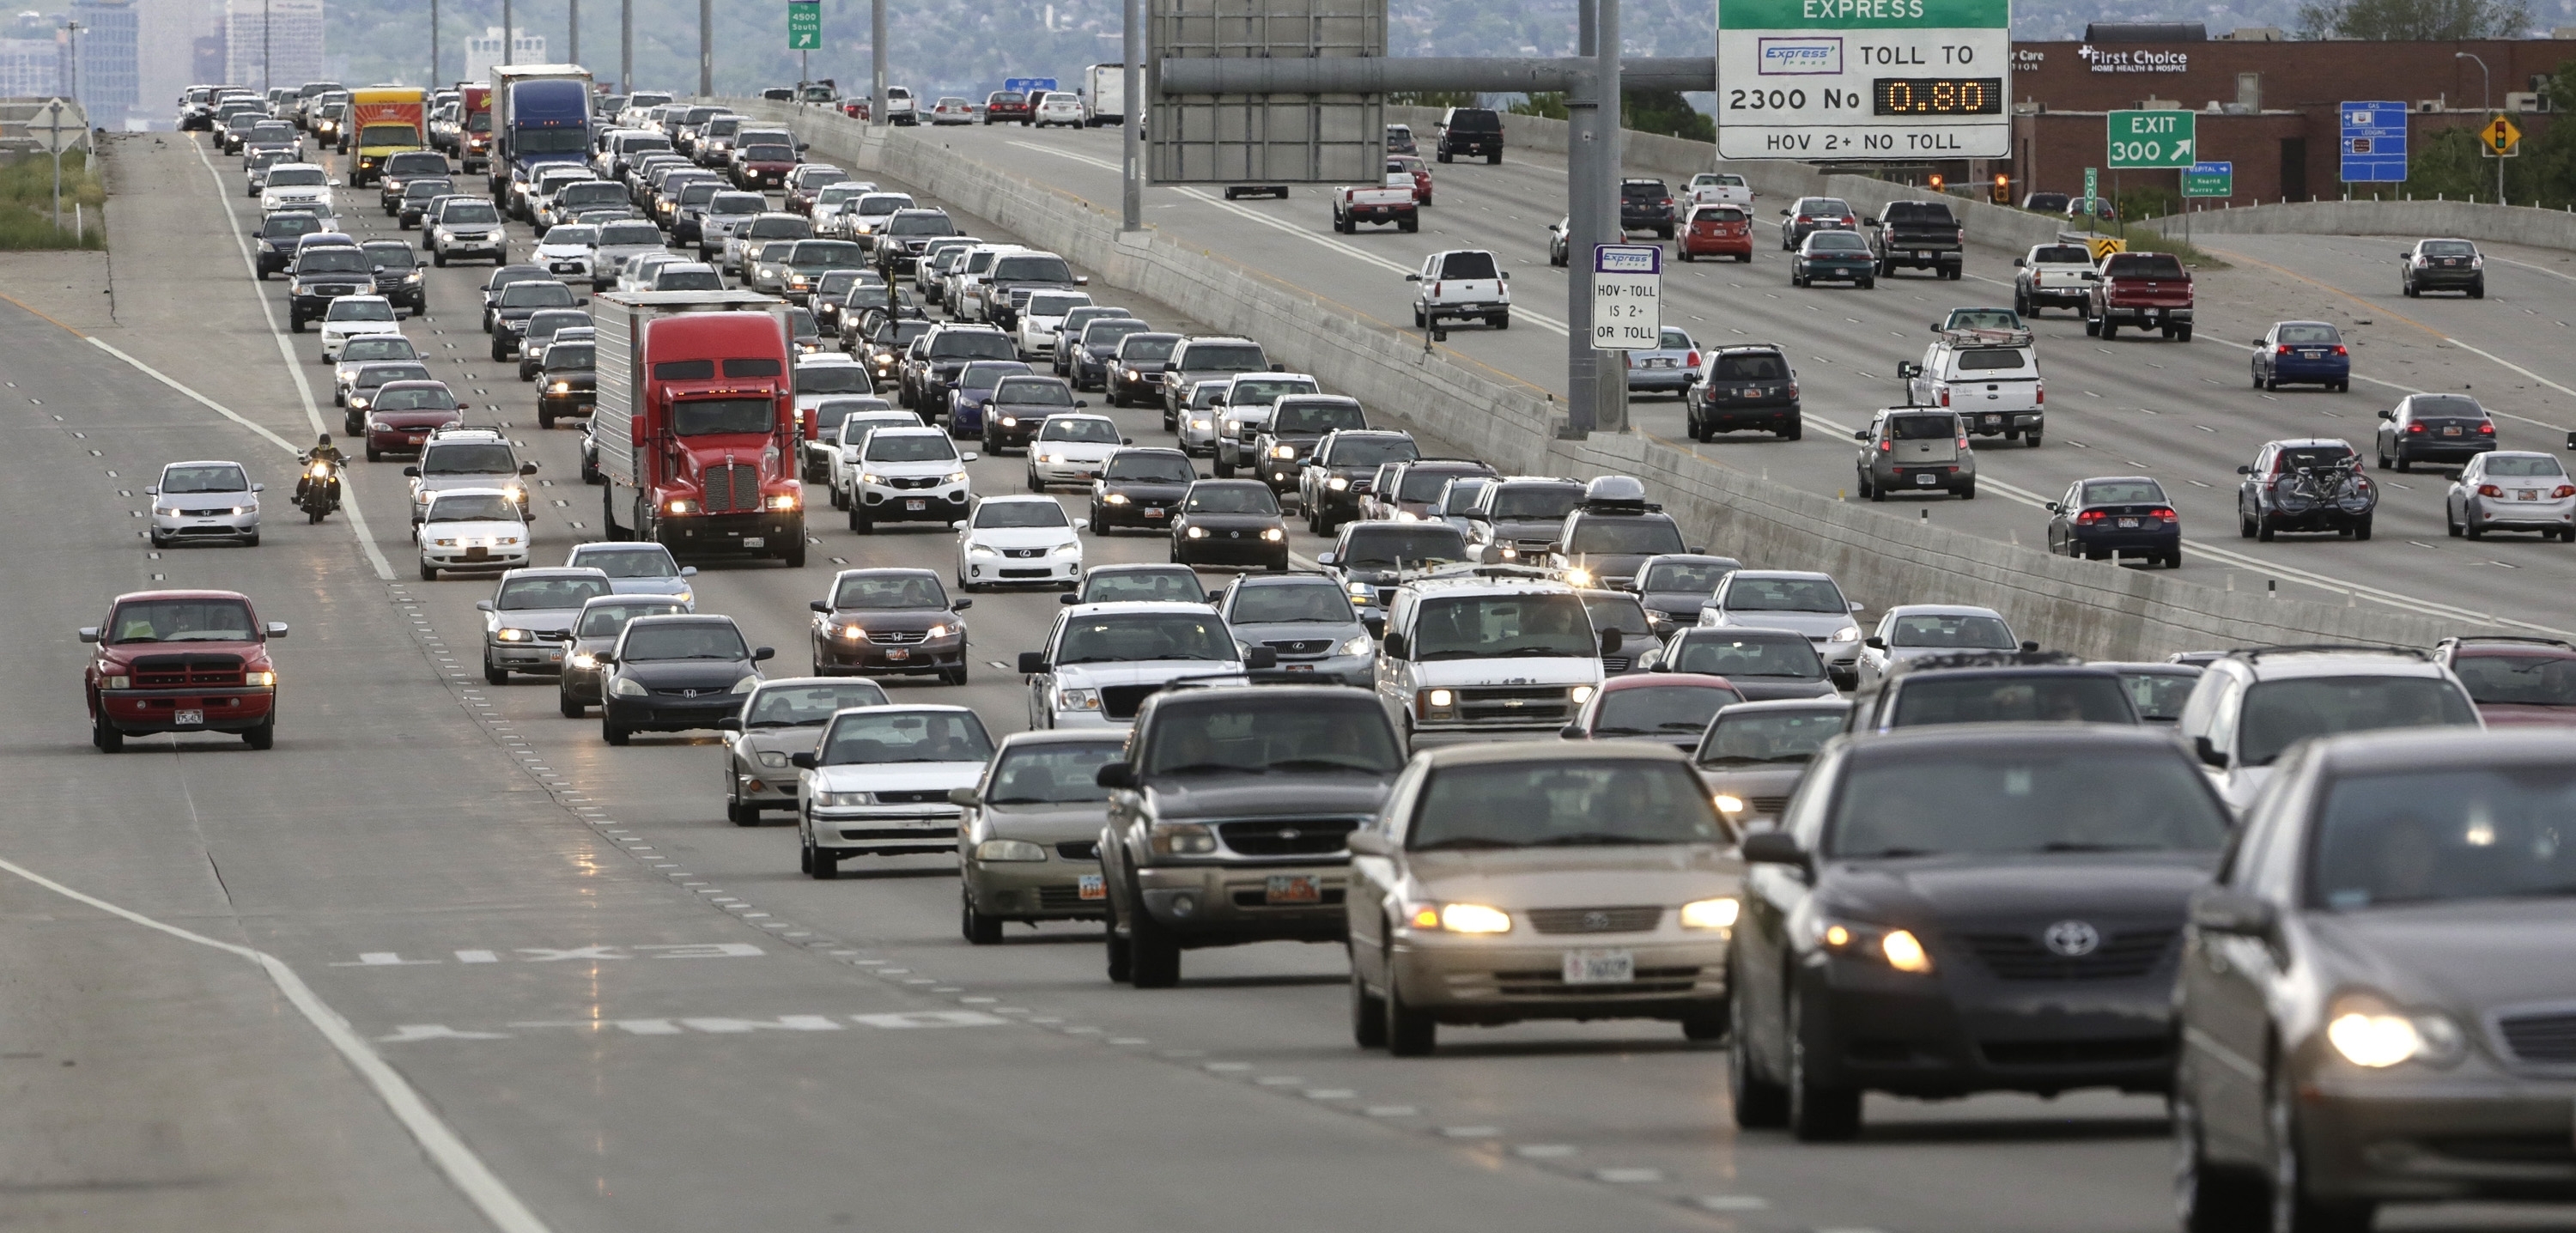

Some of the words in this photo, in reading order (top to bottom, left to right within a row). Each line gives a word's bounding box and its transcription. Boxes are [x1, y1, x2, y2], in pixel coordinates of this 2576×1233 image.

[1803, 0, 1923, 18] EXPRESS
[1765, 46, 1830, 66] Express
[1861, 46, 1925, 64] TOLL
[1942, 46, 1973, 64] TO
[2020, 50, 2044, 61] Care
[2092, 50, 2128, 64] First
[2134, 50, 2187, 64] Choice
[1730, 89, 1807, 110] 2300
[1825, 88, 1860, 109] No
[1889, 82, 1983, 112] 0.80
[2131, 116, 2177, 134] EXIT
[1767, 135, 1811, 150] HOV
[1826, 135, 1851, 150] 2+
[1864, 134, 1893, 149] NO
[1907, 134, 1961, 149] TOLL
[2111, 141, 2160, 161] 300
[1603, 252, 1649, 267] Express
[1609, 305, 1620, 317] IS
[1629, 305, 1643, 317] 2+
[1597, 326, 1614, 337] OR
[1624, 326, 1655, 339] TOLL
[329, 943, 766, 967] EXIT
